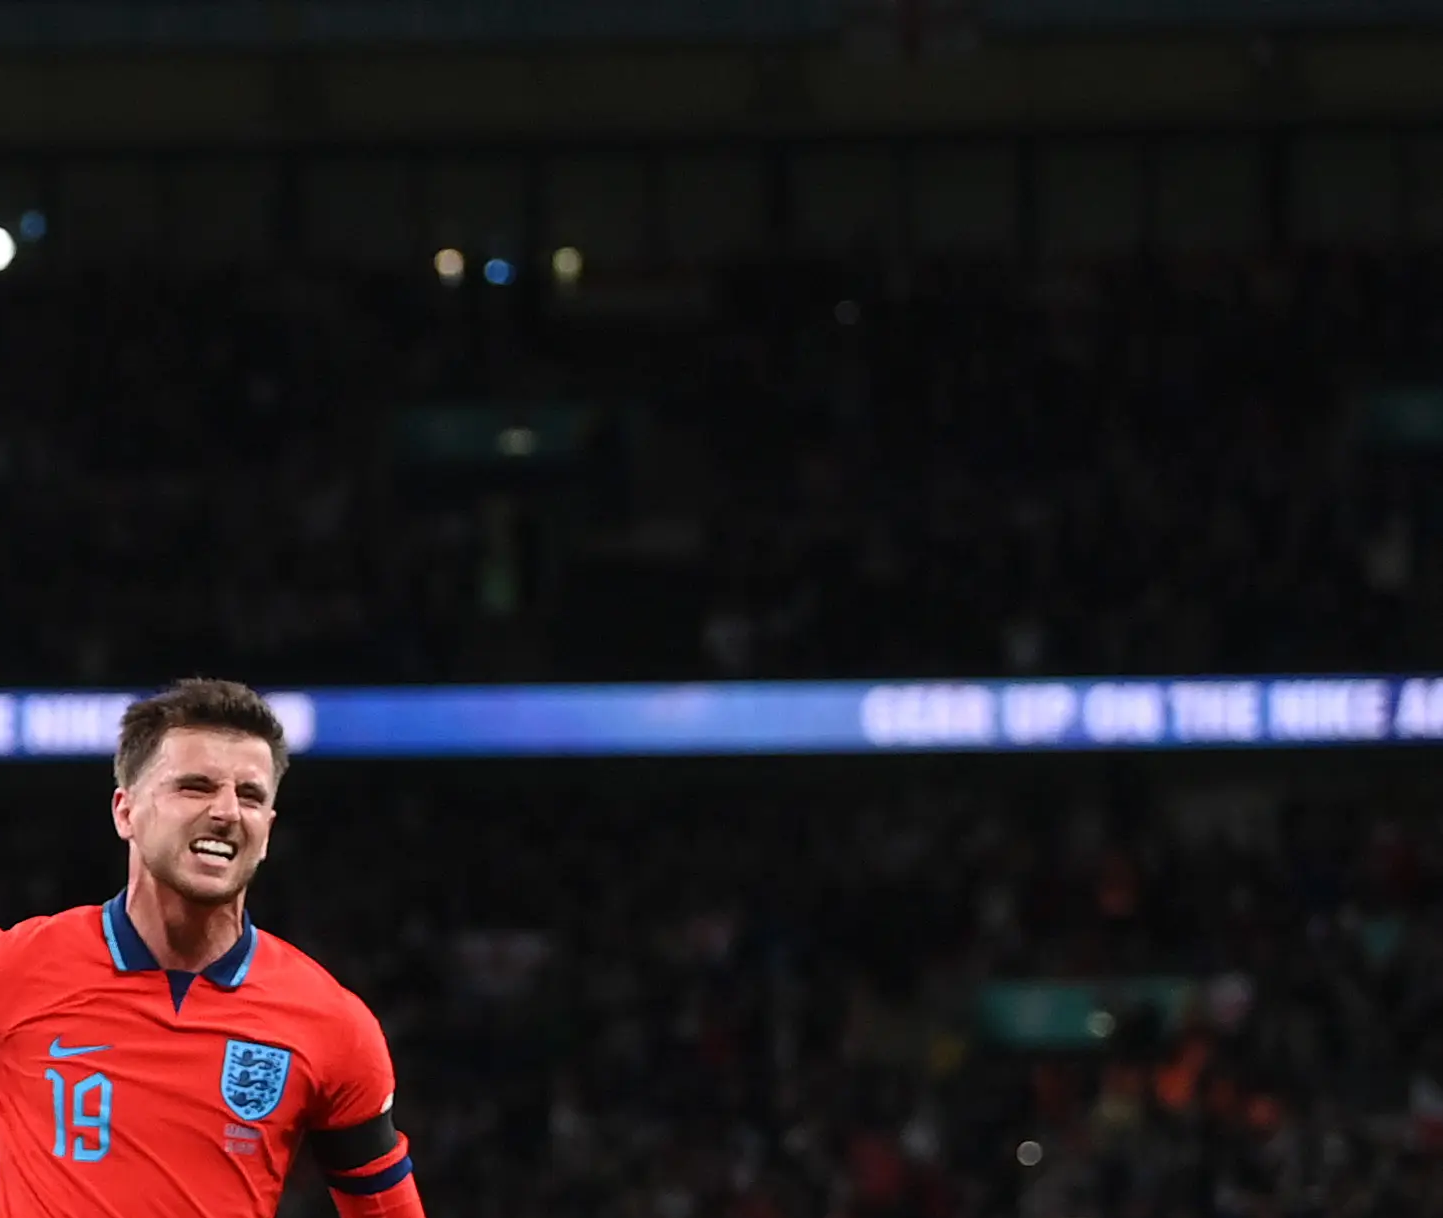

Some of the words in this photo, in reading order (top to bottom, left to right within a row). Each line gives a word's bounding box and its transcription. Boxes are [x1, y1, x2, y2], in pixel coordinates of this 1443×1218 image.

[1000, 683, 1080, 744] UP
[1081, 682, 1164, 743] ON
[1168, 681, 1261, 741] THE
[1267, 680, 1388, 739] NIKE
[44, 1068, 113, 1162] 19
